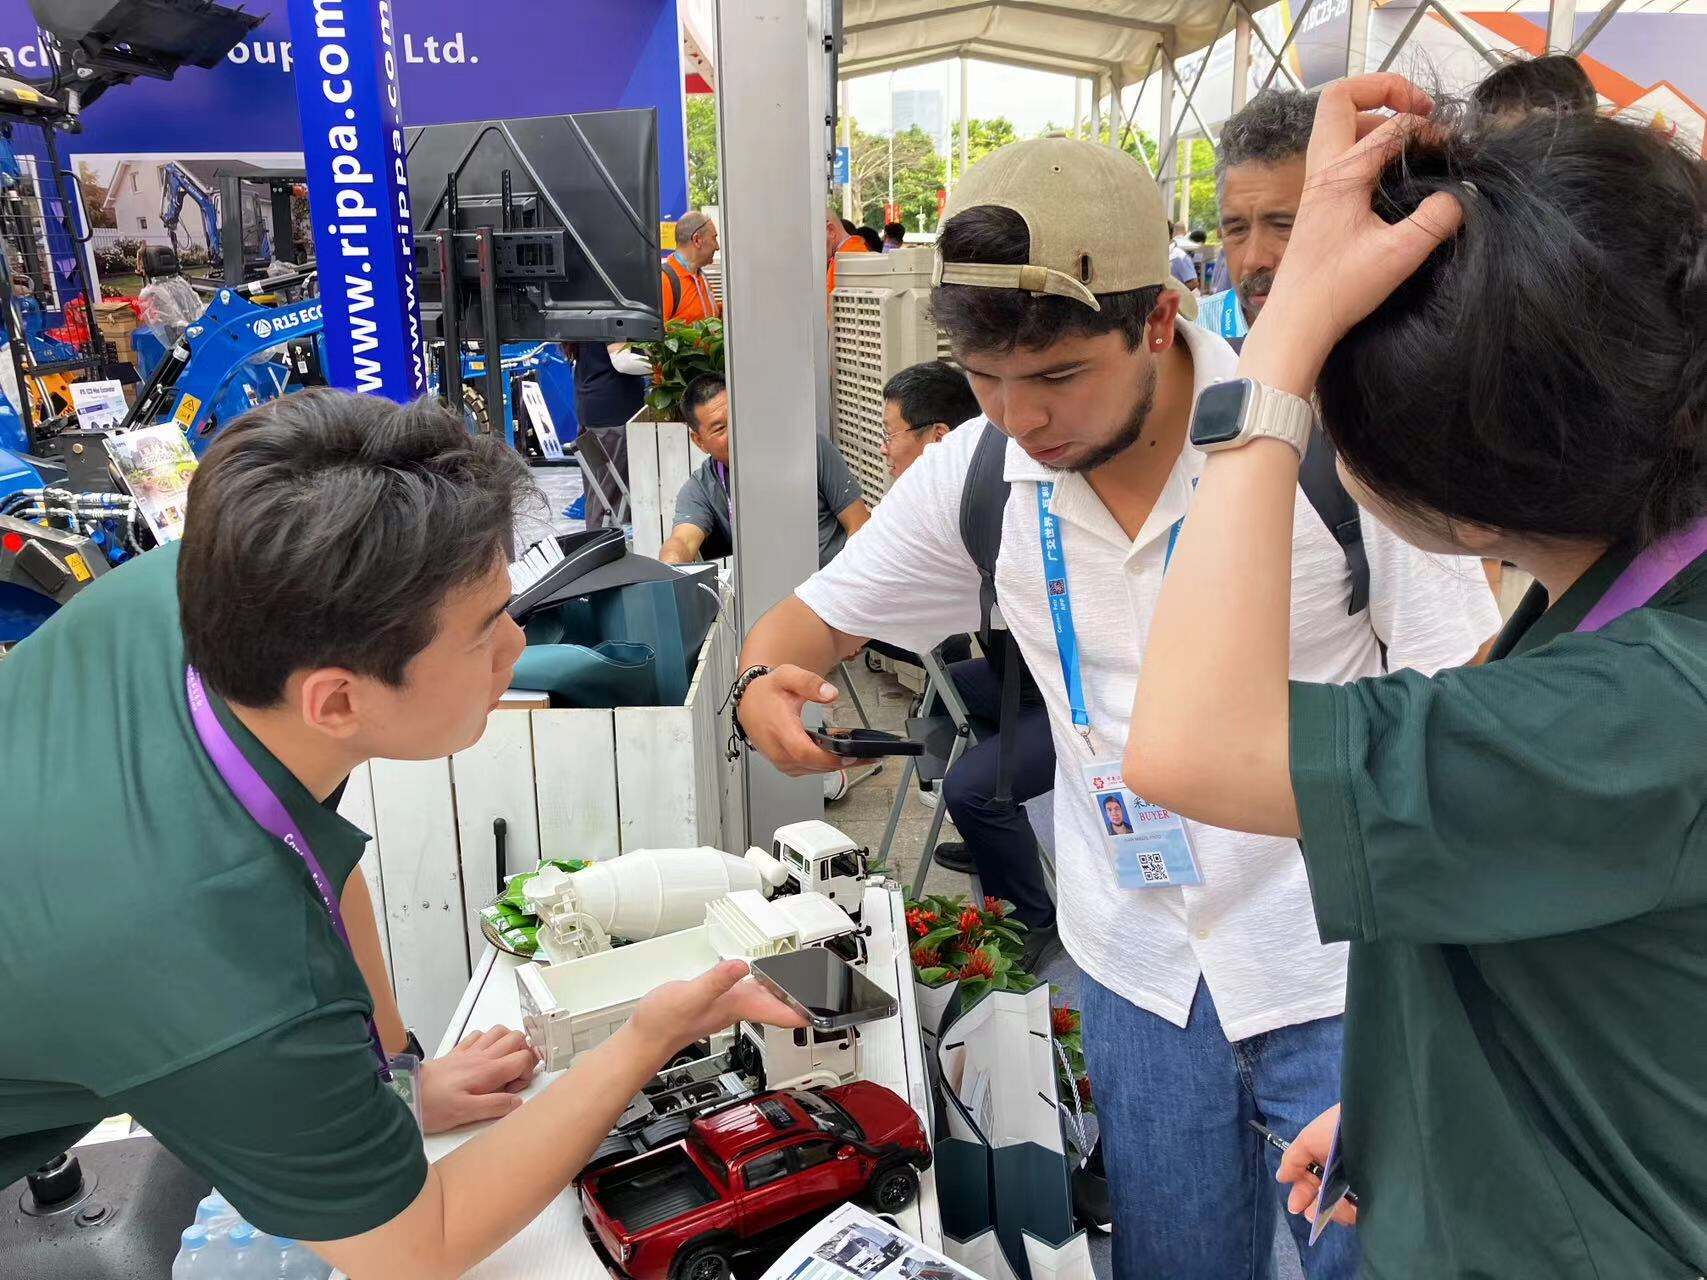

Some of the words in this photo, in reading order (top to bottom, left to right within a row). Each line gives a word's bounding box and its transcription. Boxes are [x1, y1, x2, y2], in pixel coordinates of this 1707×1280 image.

[227, 41, 294, 72] oup
[404, 33, 479, 64] Ltd.
[312, 0, 383, 393] www.rippa.com
[379, 0, 423, 390] www.rippa.com
[272, 312, 299, 331] R15
[1043, 516, 1059, 561] 广交世界
[1139, 809, 1170, 822] BUYER
